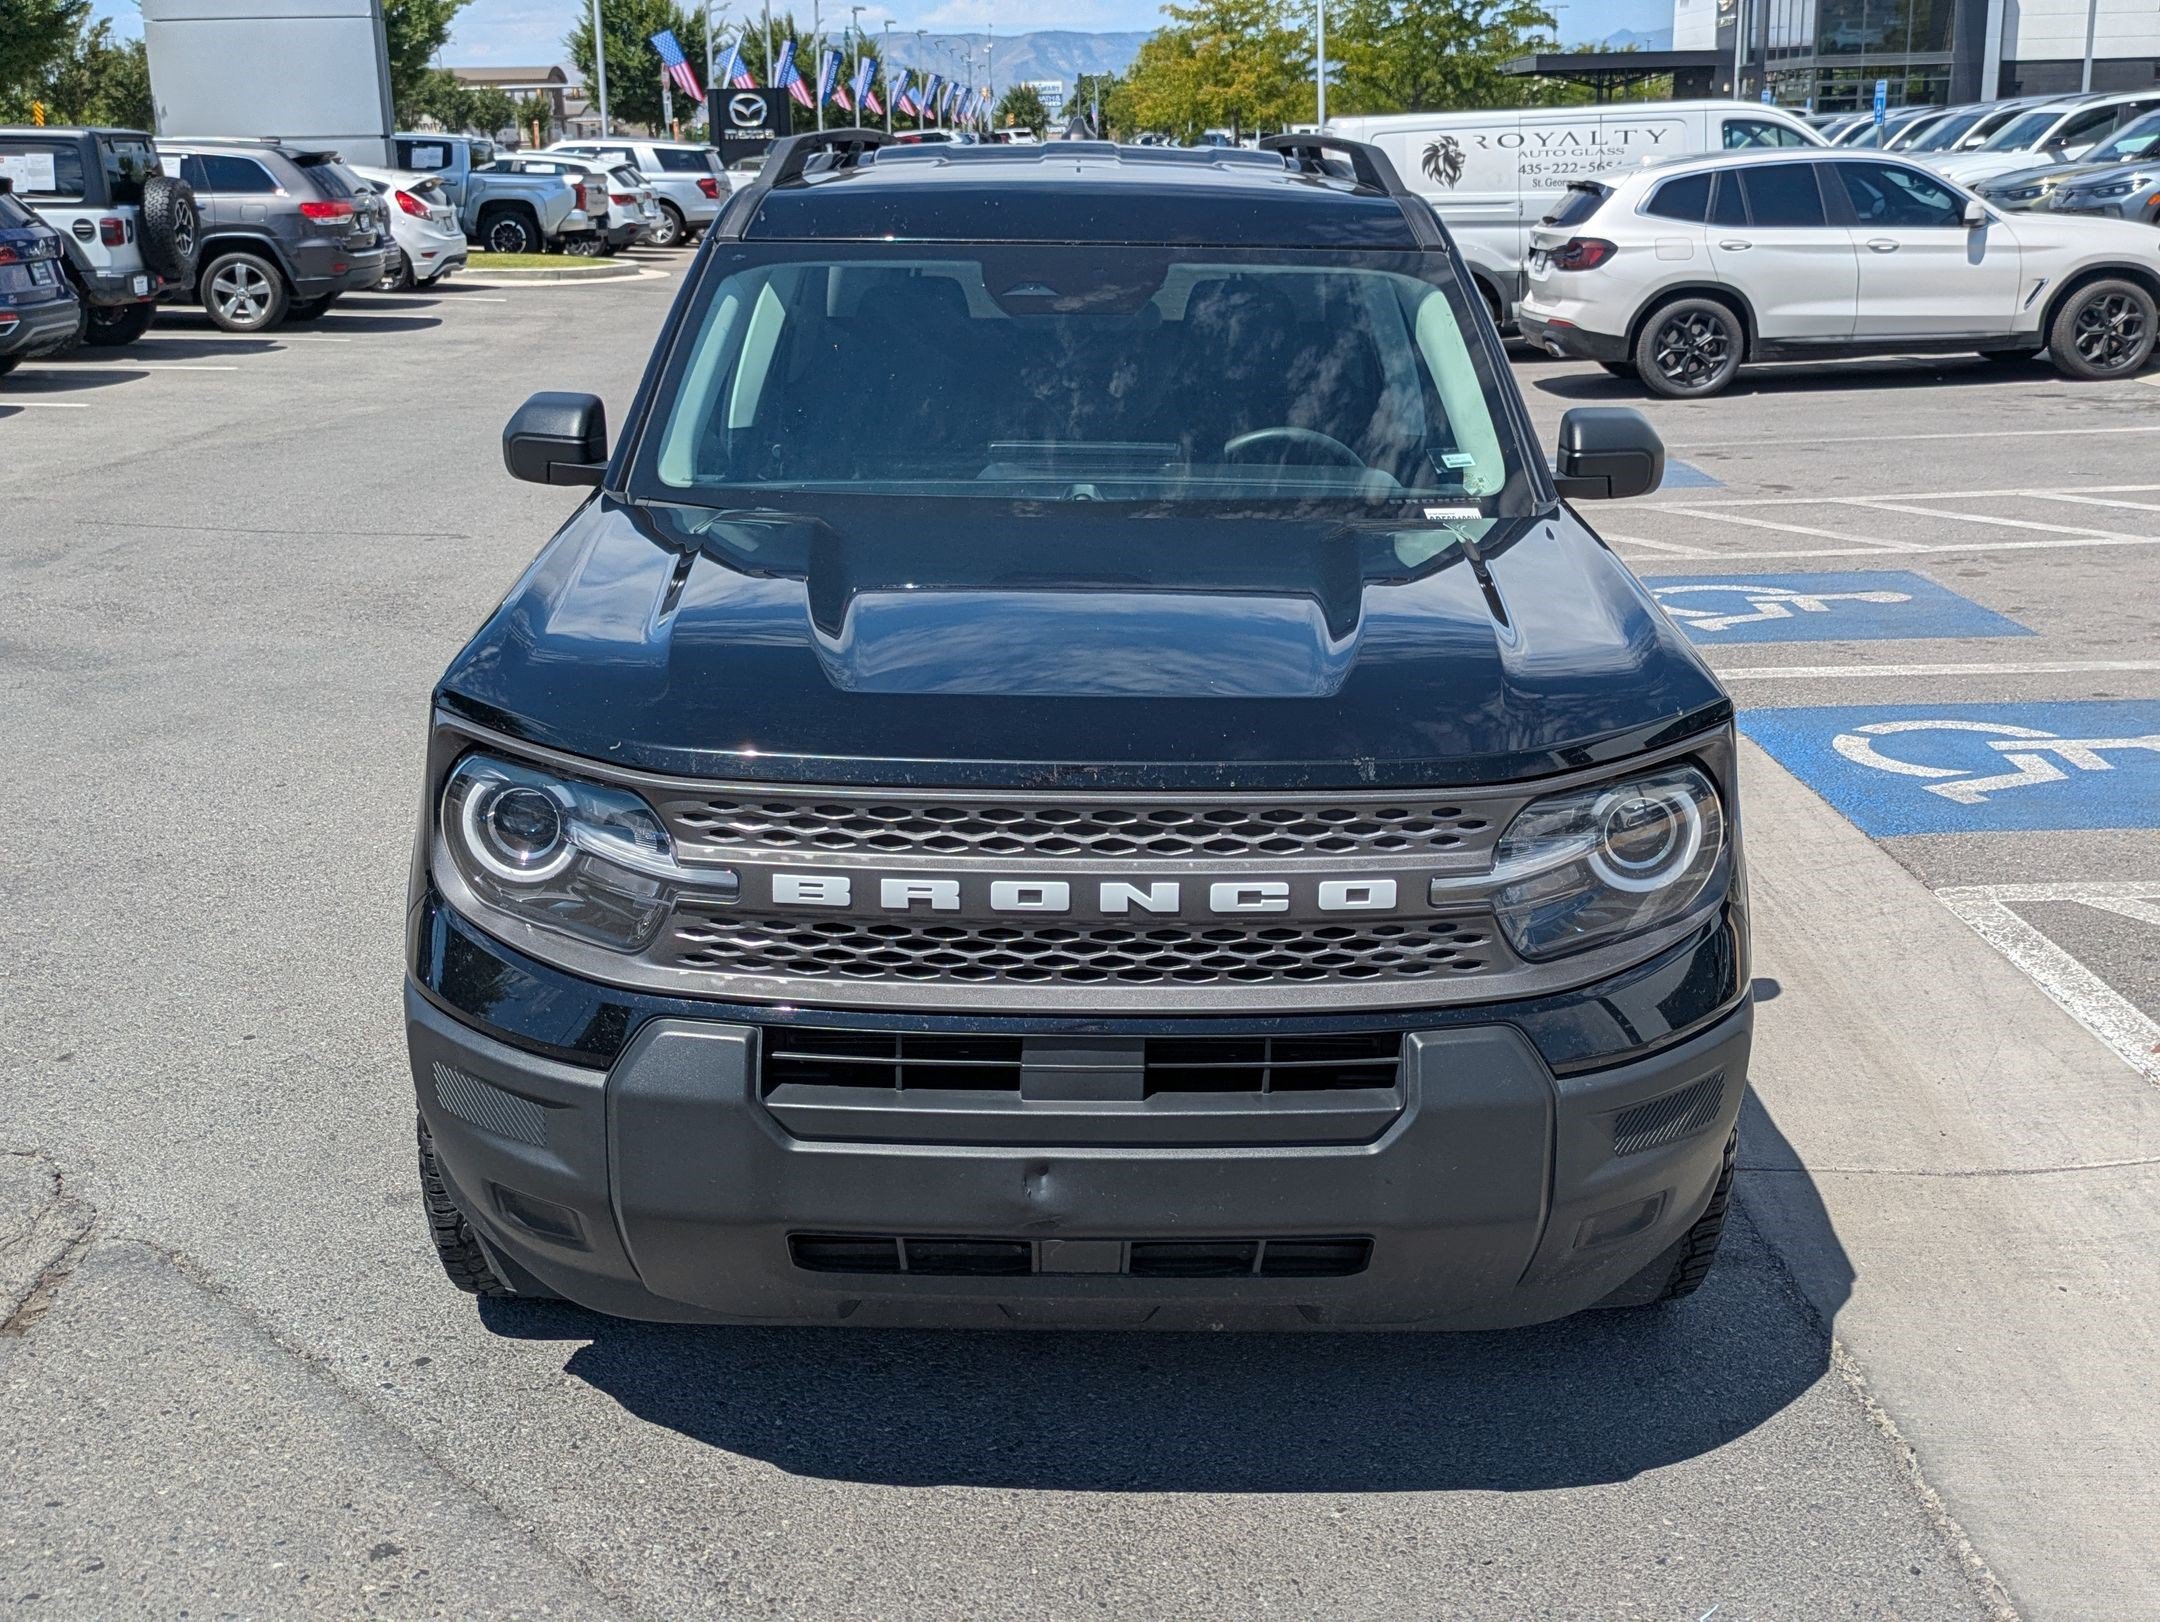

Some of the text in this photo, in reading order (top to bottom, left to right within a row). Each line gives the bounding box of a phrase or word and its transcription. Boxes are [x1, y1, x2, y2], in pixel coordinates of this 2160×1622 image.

[1472, 128, 1668, 150] ROYALTY
[1517, 147, 1625, 159] AUTO GLASS
[1517, 160, 1623, 176] 435-222-565
[1531, 177, 1568, 188] St. Geor
[772, 873, 1398, 914] BRONCO
